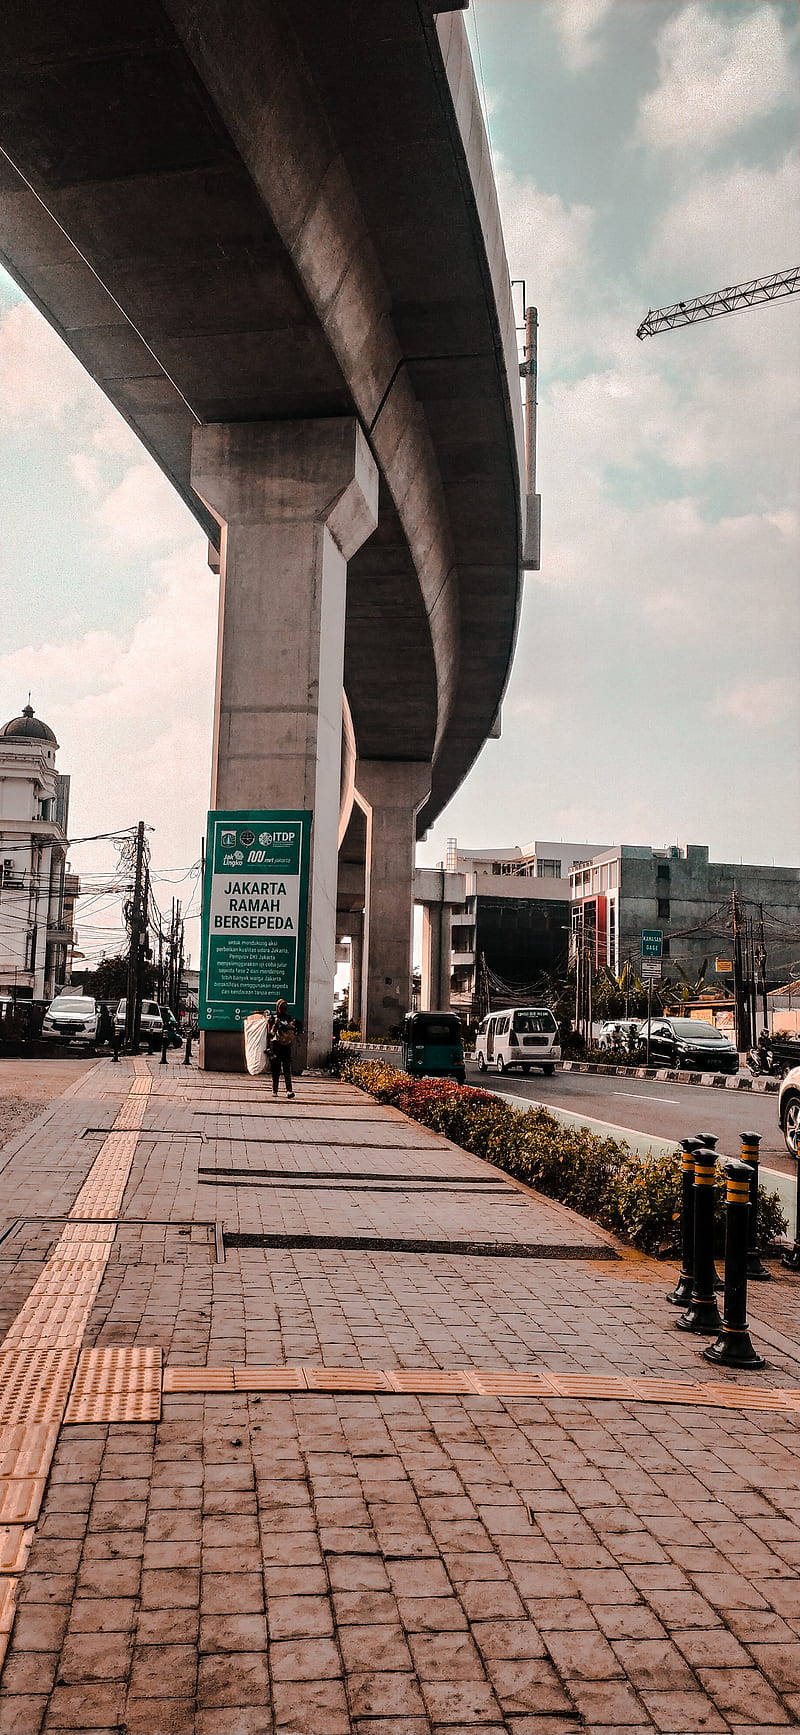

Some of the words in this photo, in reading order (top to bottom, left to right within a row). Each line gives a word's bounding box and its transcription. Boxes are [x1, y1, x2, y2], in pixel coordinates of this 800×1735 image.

[273, 832, 295, 841] ITDP
[224, 882, 287, 895] JAKARTA
[230, 899, 280, 912] RAMAH
[214, 916, 294, 930] BERSEPEDA
